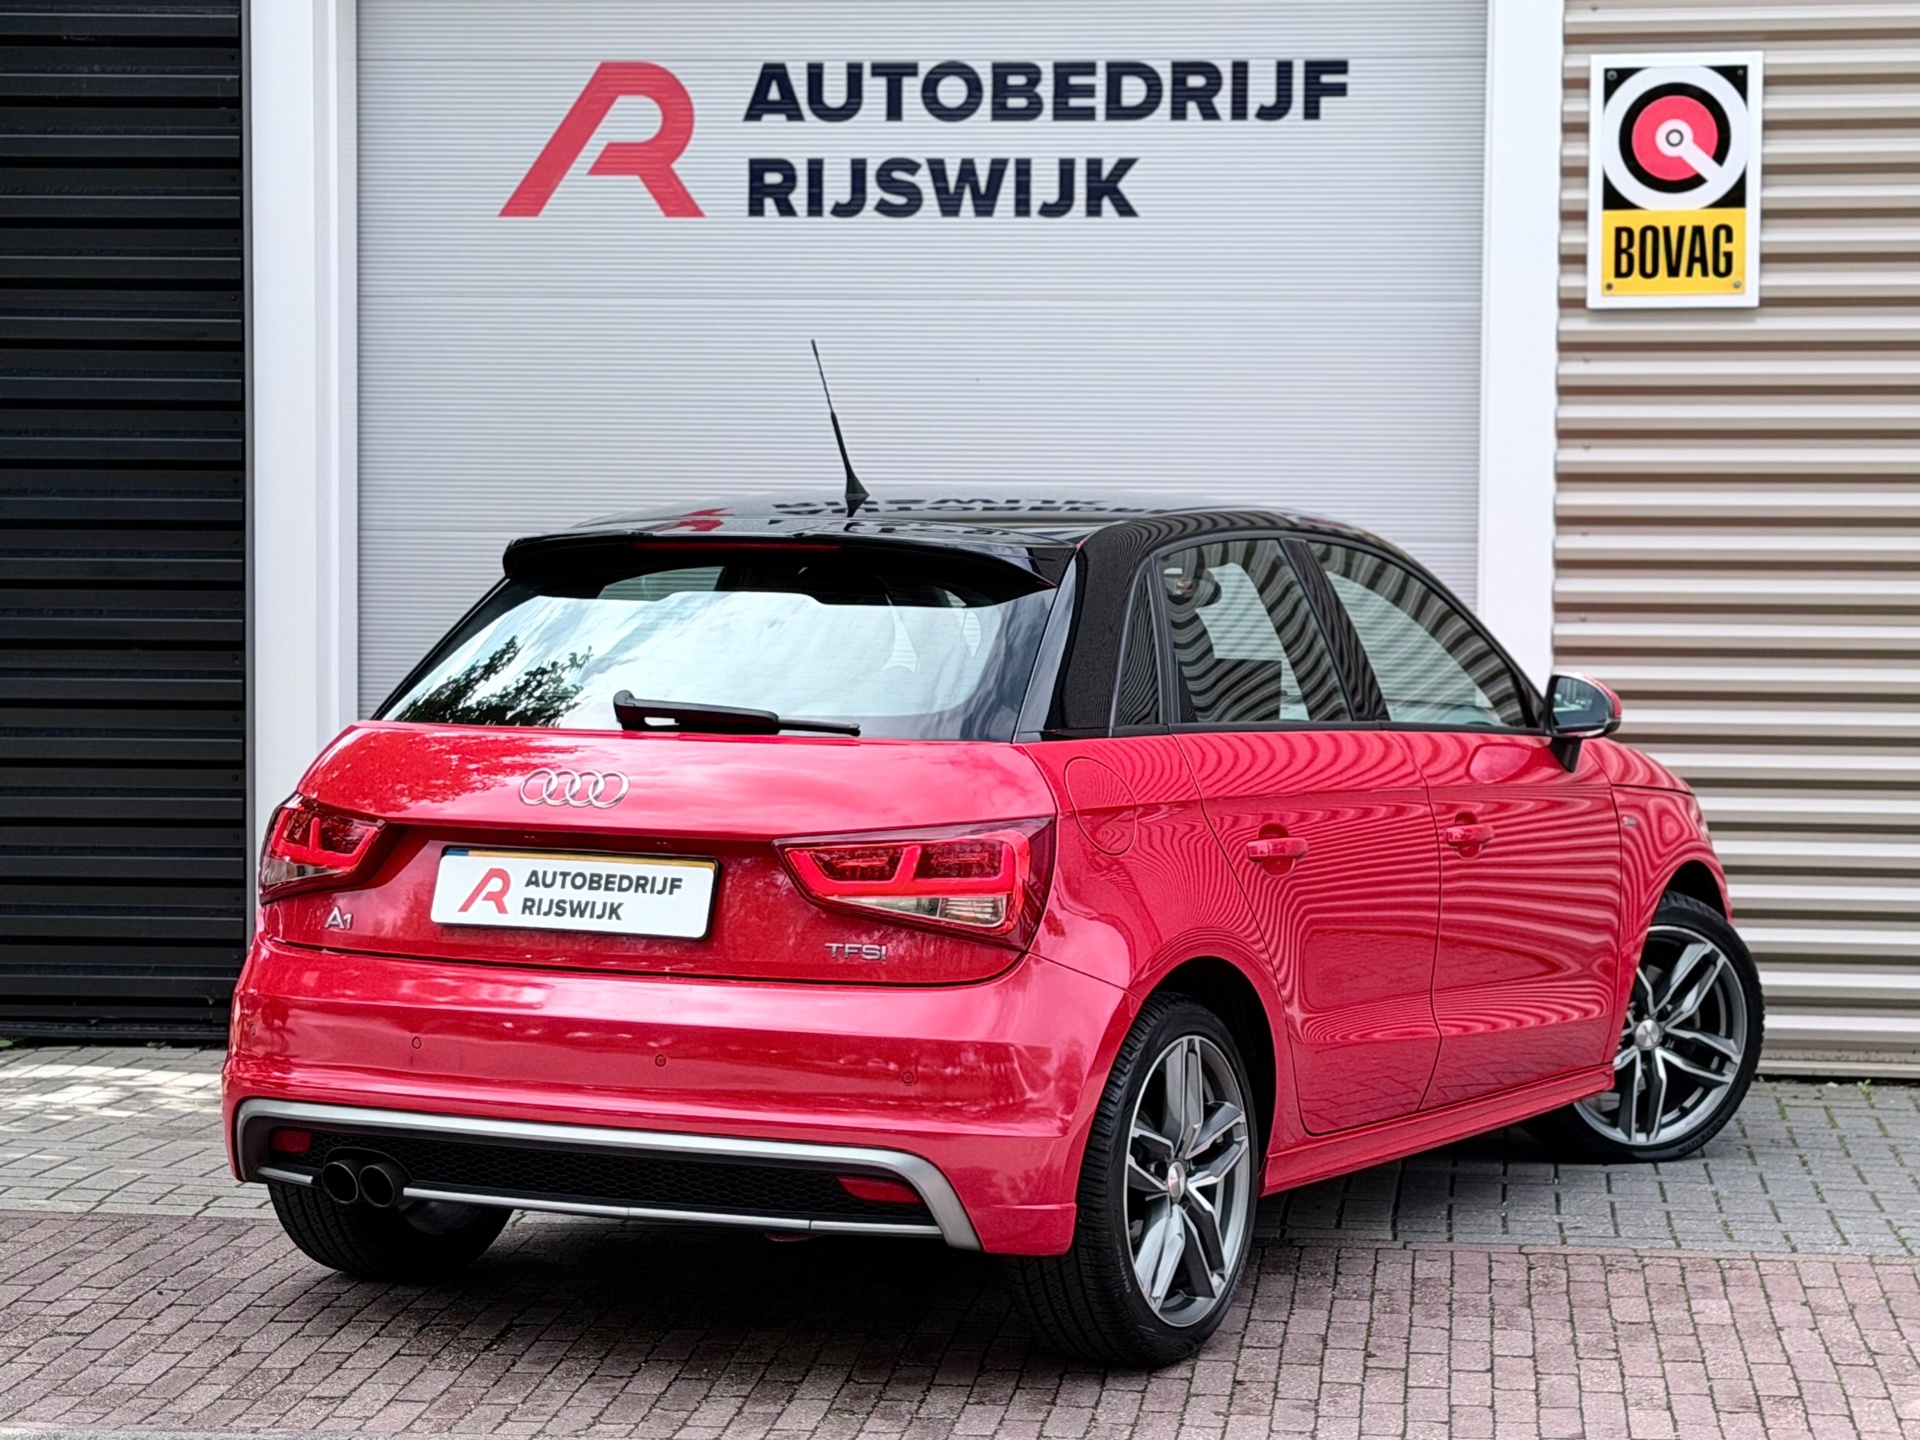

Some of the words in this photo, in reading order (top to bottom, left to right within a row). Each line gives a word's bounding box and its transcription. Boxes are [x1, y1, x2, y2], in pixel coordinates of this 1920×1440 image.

[743, 59, 1349, 123] AUTOBEDRIJF
[748, 157, 1138, 218] RIJSWIJK
[1614, 224, 1734, 279] BOVAG
[524, 869, 683, 896] AUTOBEDRIJF
[324, 906, 353, 930] A1
[521, 897, 624, 921] RIJSWIJK
[825, 943, 887, 960] TFSI
